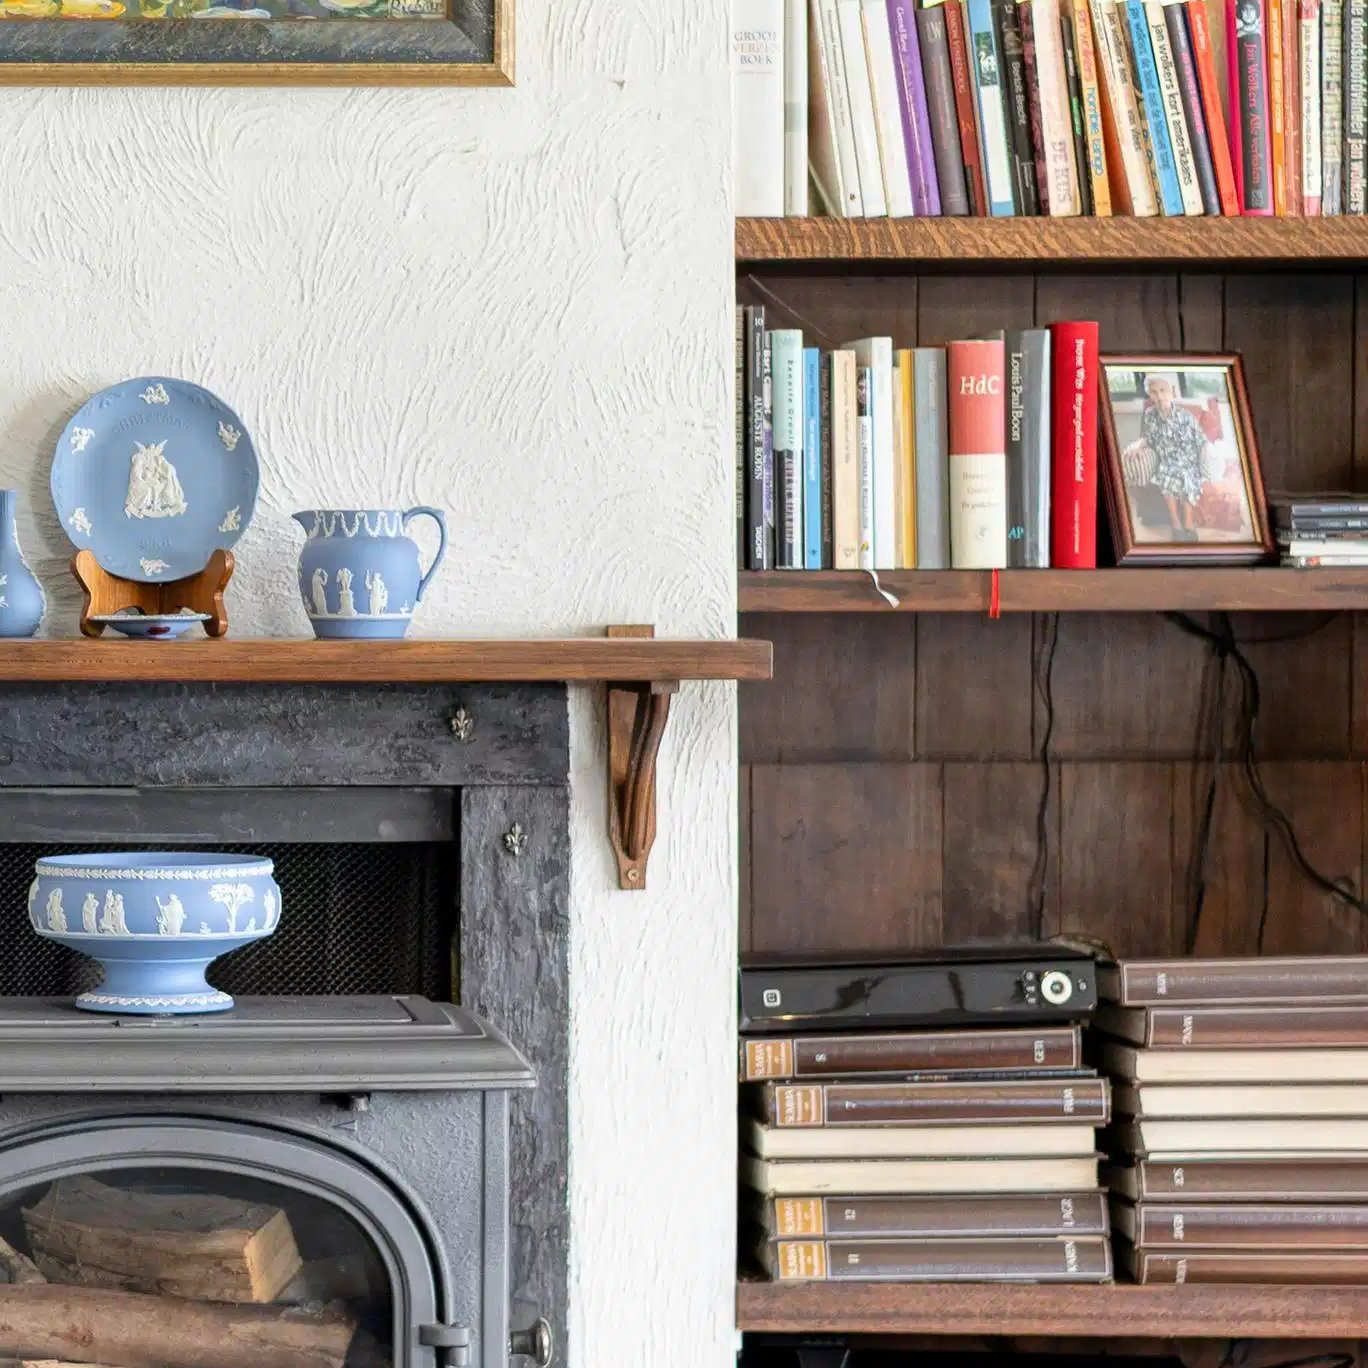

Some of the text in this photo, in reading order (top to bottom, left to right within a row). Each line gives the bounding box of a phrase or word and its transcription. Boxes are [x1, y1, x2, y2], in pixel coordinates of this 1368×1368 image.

[1151, 23, 1165, 42] jan
[1158, 44, 1176, 90] wolkers
[1244, 43, 1258, 61] Jan
[1247, 63, 1260, 107] Wolkers
[1015, 94, 1027, 126] Brecht
[1168, 92, 1180, 117] kort
[1347, 0, 1367, 212] de doodshoofdvlinder jan wolkers
[1173, 120, 1192, 186] amerikaans
[763, 349, 772, 374] Bart
[959, 375, 1001, 396] HdC
[1011, 352, 1023, 441] Louis Paul Boon
[753, 395, 764, 480] AUGUSTE RODIN
[754, 525, 763, 559] TASCHEN
